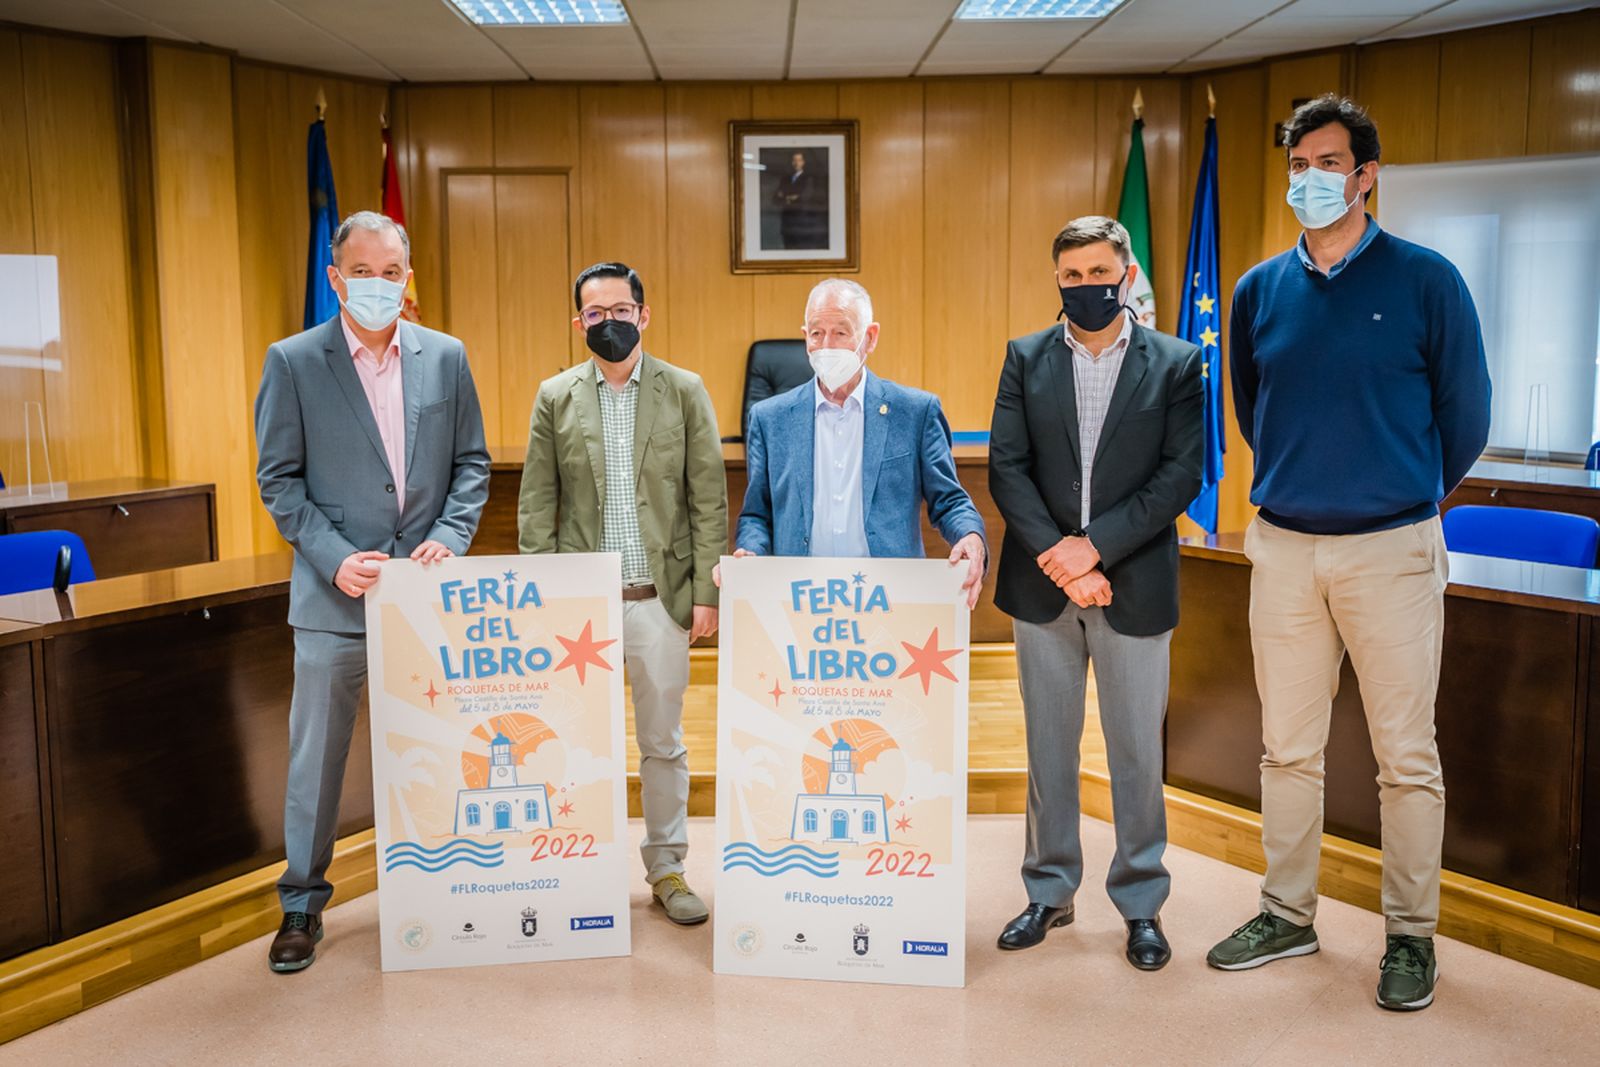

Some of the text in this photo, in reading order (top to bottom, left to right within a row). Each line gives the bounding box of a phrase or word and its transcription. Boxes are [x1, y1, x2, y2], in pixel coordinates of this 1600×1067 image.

[439, 645, 552, 680] LIBRO
[787, 645, 897, 681] LIBRO
[447, 682, 550, 695] ROQUETAS DE MAR
[792, 686, 893, 698] ROQUETAS DE MAR
[459, 703, 472, 713] del
[474, 703, 480, 712] 5
[803, 706, 815, 715] del
[817, 706, 823, 715] 5
[856, 708, 882, 717] MAYO
[530, 833, 599, 862] 2022
[865, 848, 935, 877] 2022
[450, 878, 560, 895] #FLRoquetas2022
[784, 891, 894, 907] #FLRoquetas2022
